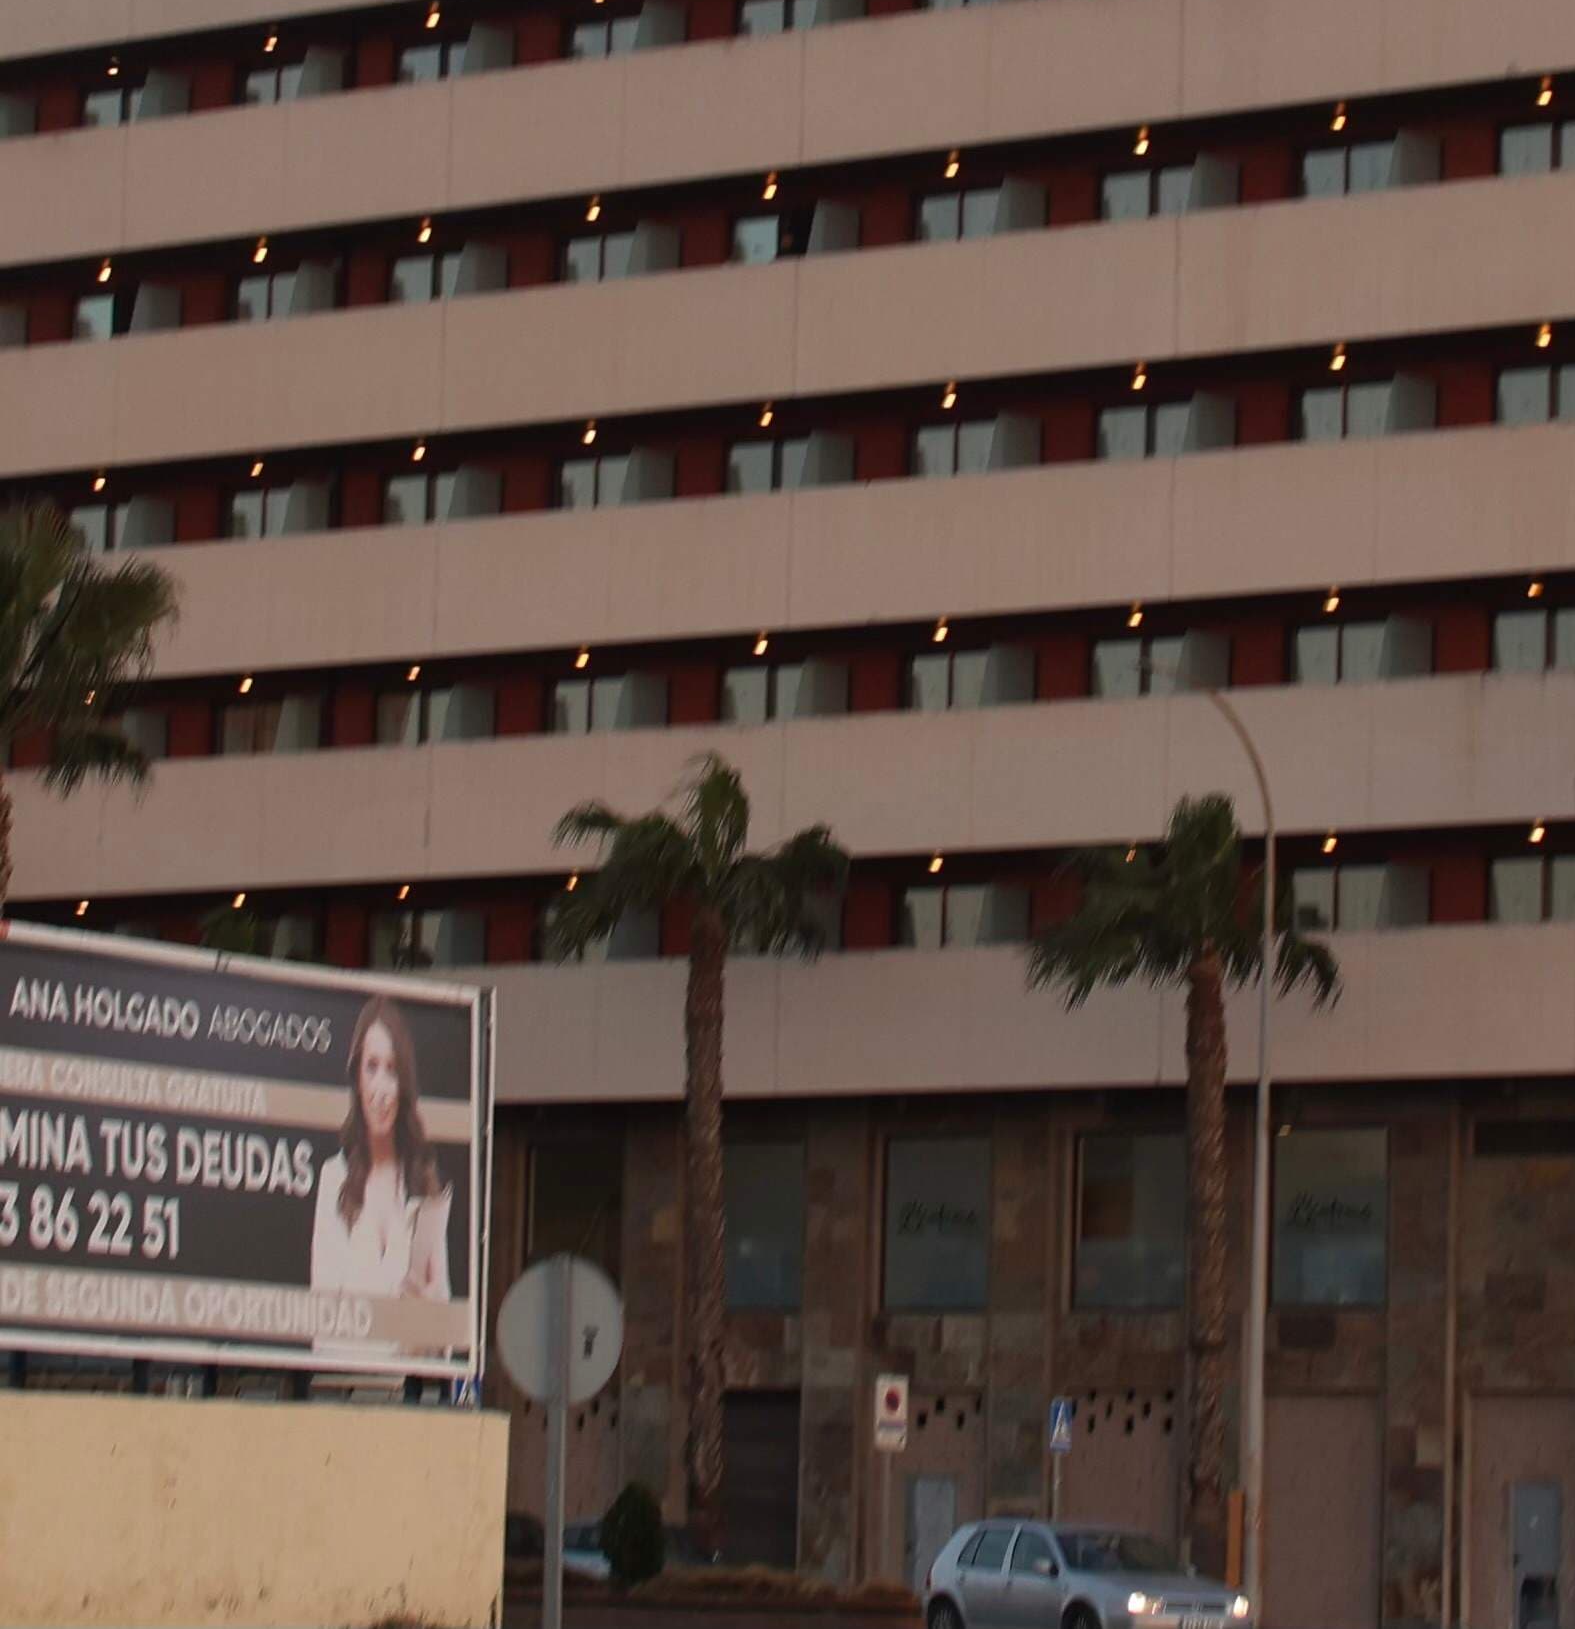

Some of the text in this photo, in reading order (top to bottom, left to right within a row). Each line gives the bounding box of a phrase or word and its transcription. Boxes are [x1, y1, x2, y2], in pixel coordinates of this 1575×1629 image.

[9, 976, 333, 1055] ANA HOLGADO ABOGADOS
[51, 1055, 162, 1105] CONSULTA
[167, 1071, 267, 1118] GRATUITA
[0, 1107, 314, 1199] MINA TUS DEUDAS
[30, 1184, 79, 1254] 86
[87, 1189, 133, 1256] 22
[142, 1194, 180, 1260] 51
[1, 1267, 373, 1338] DE SEGUNDA OPORTUNIDAD
